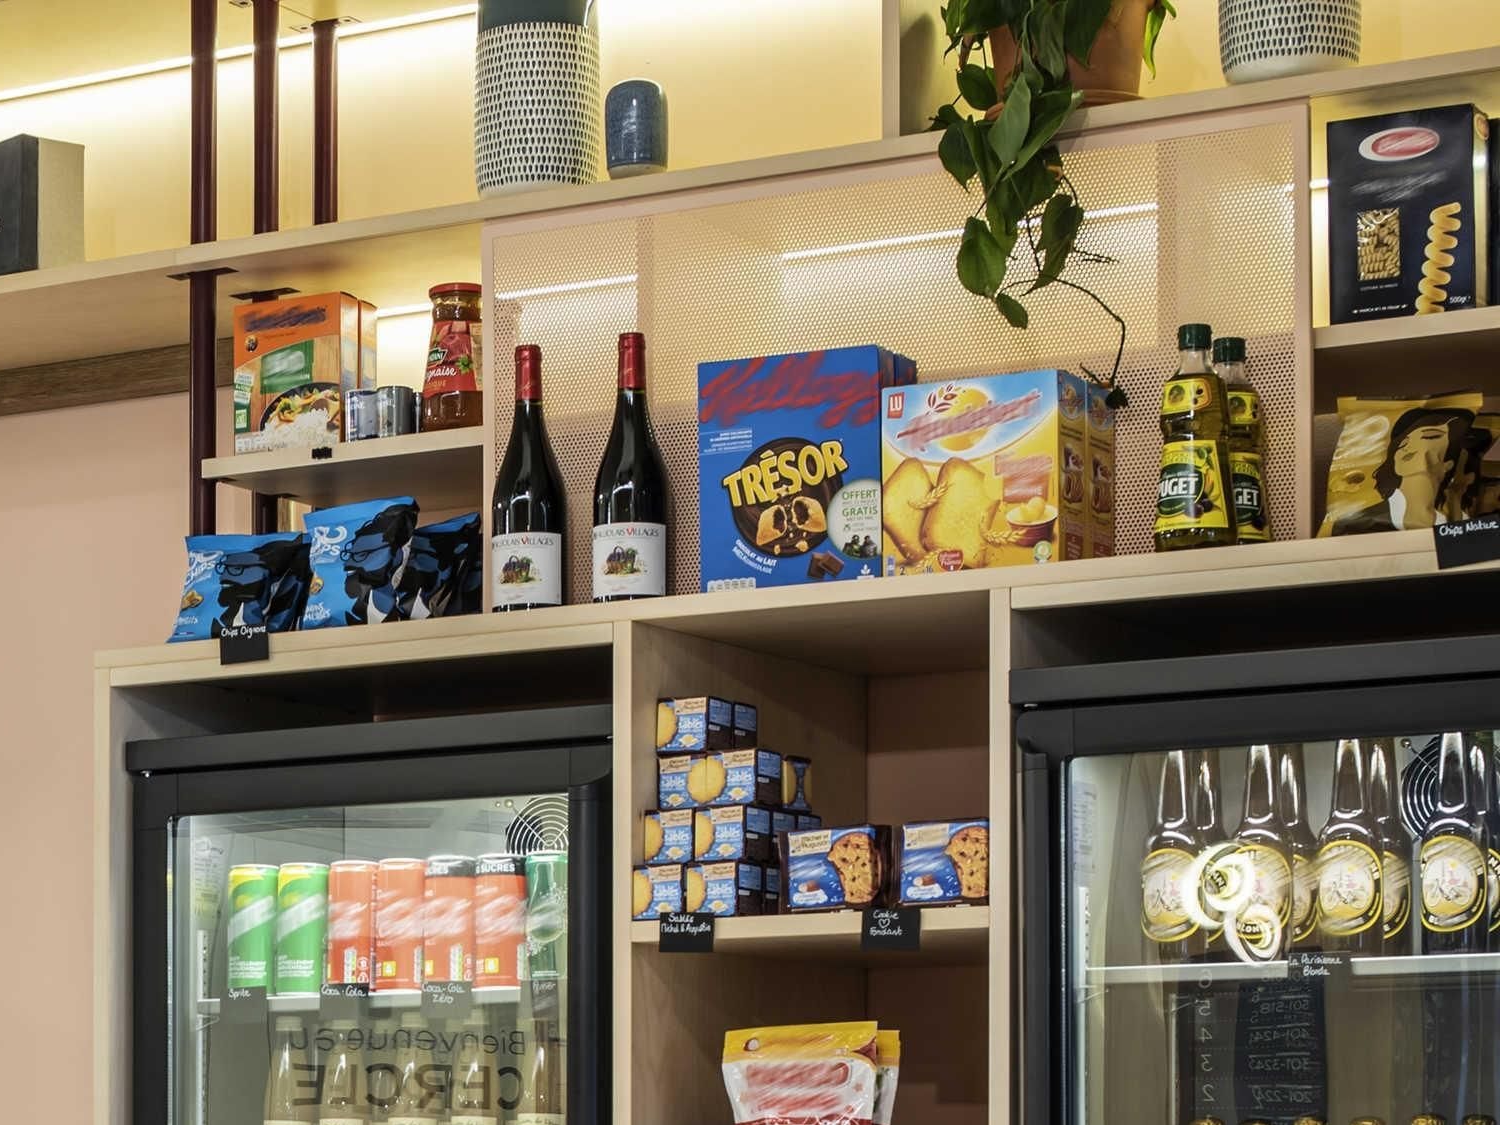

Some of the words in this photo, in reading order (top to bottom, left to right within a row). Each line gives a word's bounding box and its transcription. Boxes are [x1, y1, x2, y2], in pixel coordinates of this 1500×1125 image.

[889, 396, 902, 408] LU
[723, 440, 848, 507] TRÉSOR
[842, 488, 877, 500] OFFERT
[842, 505, 878, 517] GRATIS
[626, 527, 659, 537] VILLAGES
[1438, 523, 1464, 538] Chips
[1465, 519, 1499, 533] Nature
[521, 535, 554, 546] VILLAGES
[763, 557, 777, 567] LAIT
[220, 627, 239, 639] Chips
[481, 863, 515, 873] SUCRES
[873, 909, 899, 920] Cookie
[869, 925, 903, 936] Fondant
[228, 988, 252, 1001] Sprite
